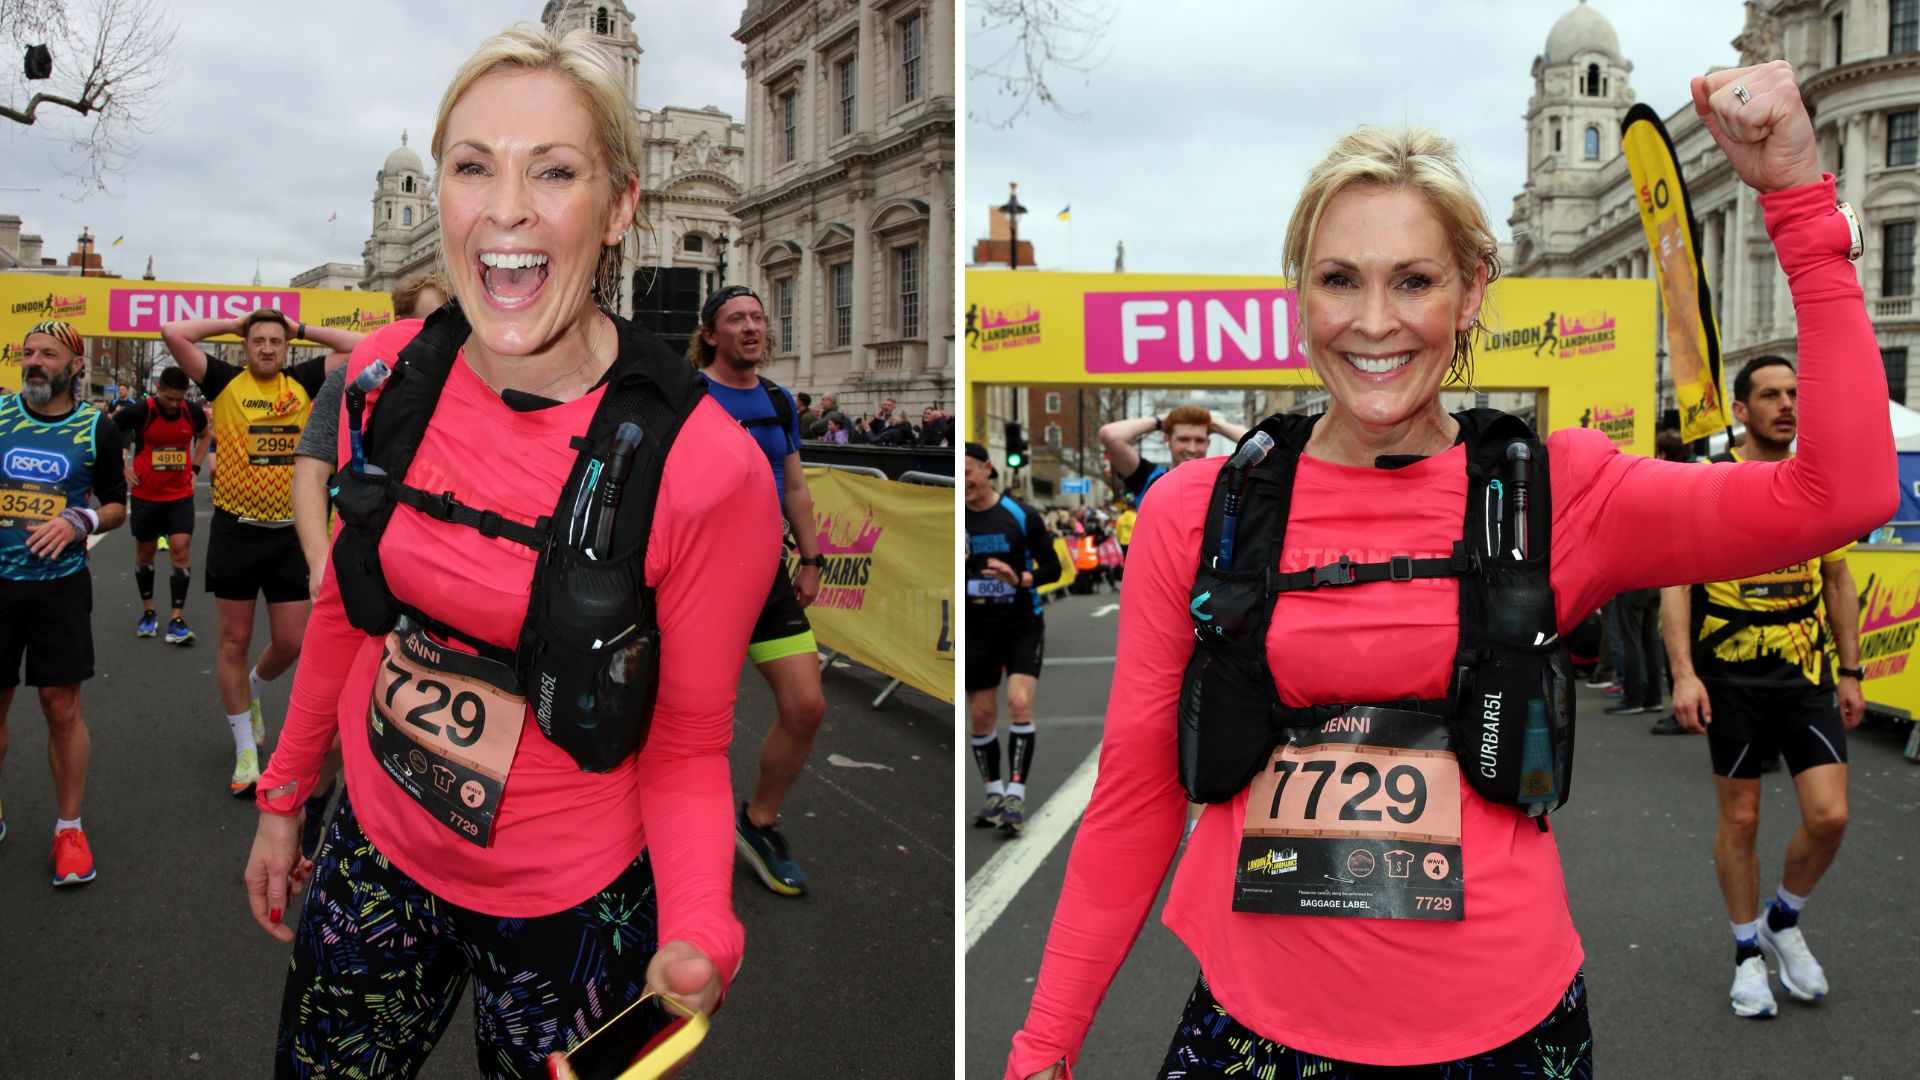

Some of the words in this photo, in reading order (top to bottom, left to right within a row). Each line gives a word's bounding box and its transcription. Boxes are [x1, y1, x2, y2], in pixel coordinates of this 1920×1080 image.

[11, 301, 44, 313] LONDON
[54, 304, 86, 313] LANDMARKS
[321, 314, 352, 327] LONDON
[1121, 298, 1307, 364] FINI
[981, 322, 1040, 343] LANDMARKS
[1484, 326, 1540, 351] LONDON
[1560, 329, 1615, 350] LANDMARKS
[257, 437, 295, 452] 2994
[11, 455, 61, 476] RSPCA
[158, 453, 183, 463] 4910
[2, 494, 56, 516] 3542
[787, 556, 872, 586] LAMARKS
[812, 587, 866, 610] ARATHON
[978, 582, 1005, 594] 808
[936, 599, 955, 652] L
[536, 672, 557, 736] CURBAR5L
[1321, 717, 1371, 734] JENNI
[1480, 691, 1502, 779] CURBAR5L
[465, 784, 482, 796] WAVE
[466, 794, 475, 803] 4
[1269, 760, 1428, 824] 7729
[449, 810, 479, 836] 7729
[1432, 865, 1441, 875] 4
[1300, 899, 1341, 908] BAGGAGE
[1343, 900, 1370, 909] LABEL
[1415, 896, 1453, 911] 7729
